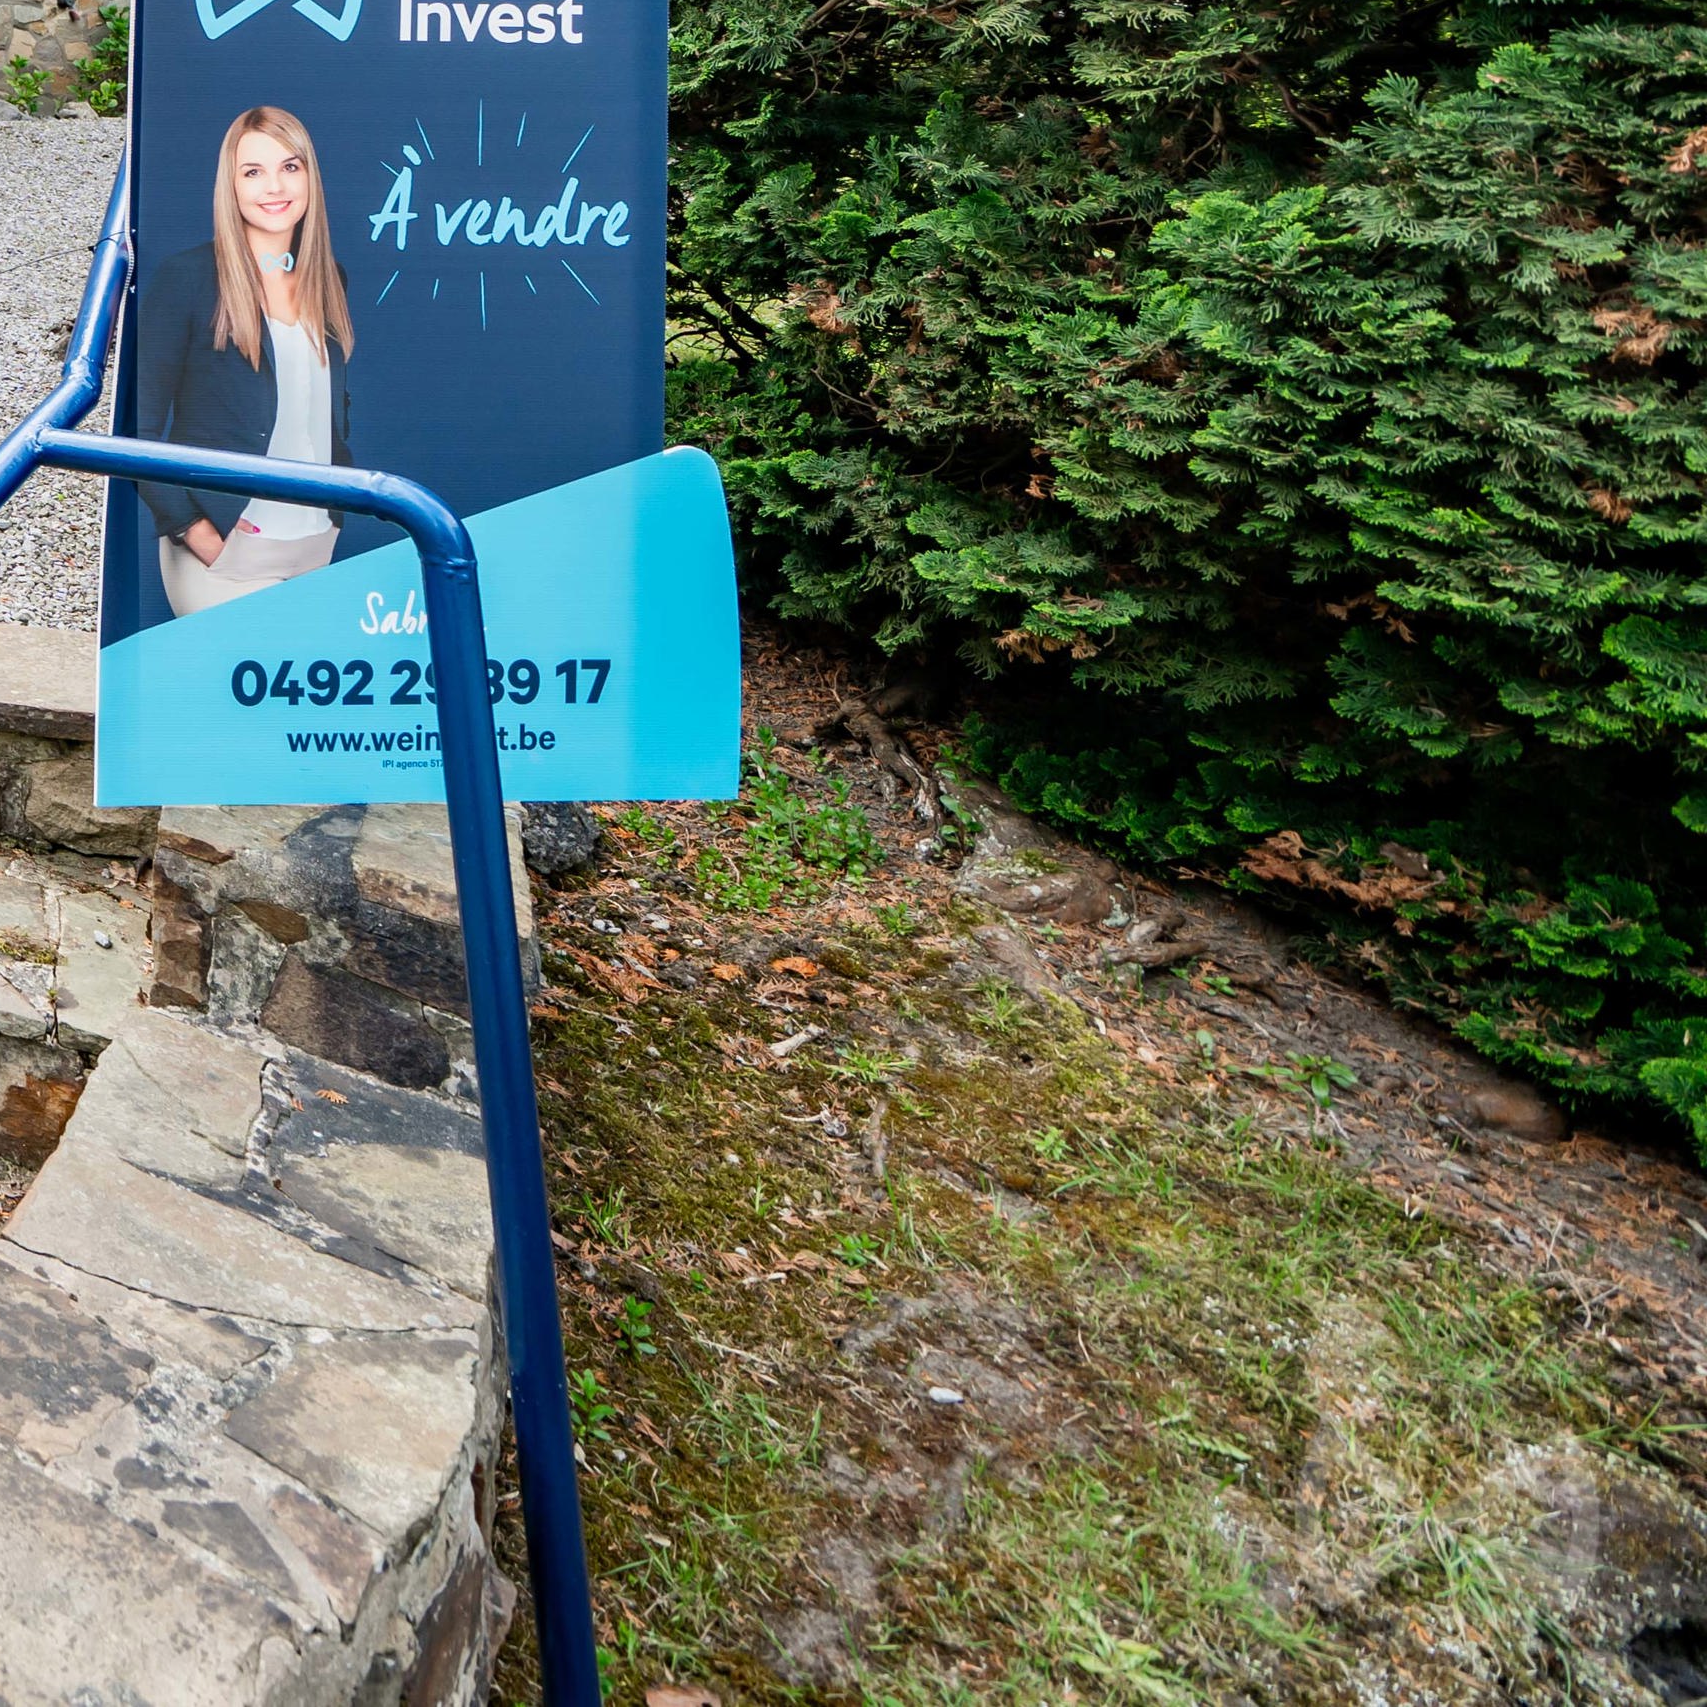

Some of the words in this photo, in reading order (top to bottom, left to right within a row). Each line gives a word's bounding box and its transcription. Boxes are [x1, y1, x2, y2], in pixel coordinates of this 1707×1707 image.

[368, 145, 421, 251] À
[434, 176, 632, 248] vendre
[231, 659, 374, 707] 0492
[555, 659, 611, 704] 17
[286, 723, 556, 752] www.weint.be
[382, 759, 394, 768] IPI
[396, 760, 428, 770] agence
